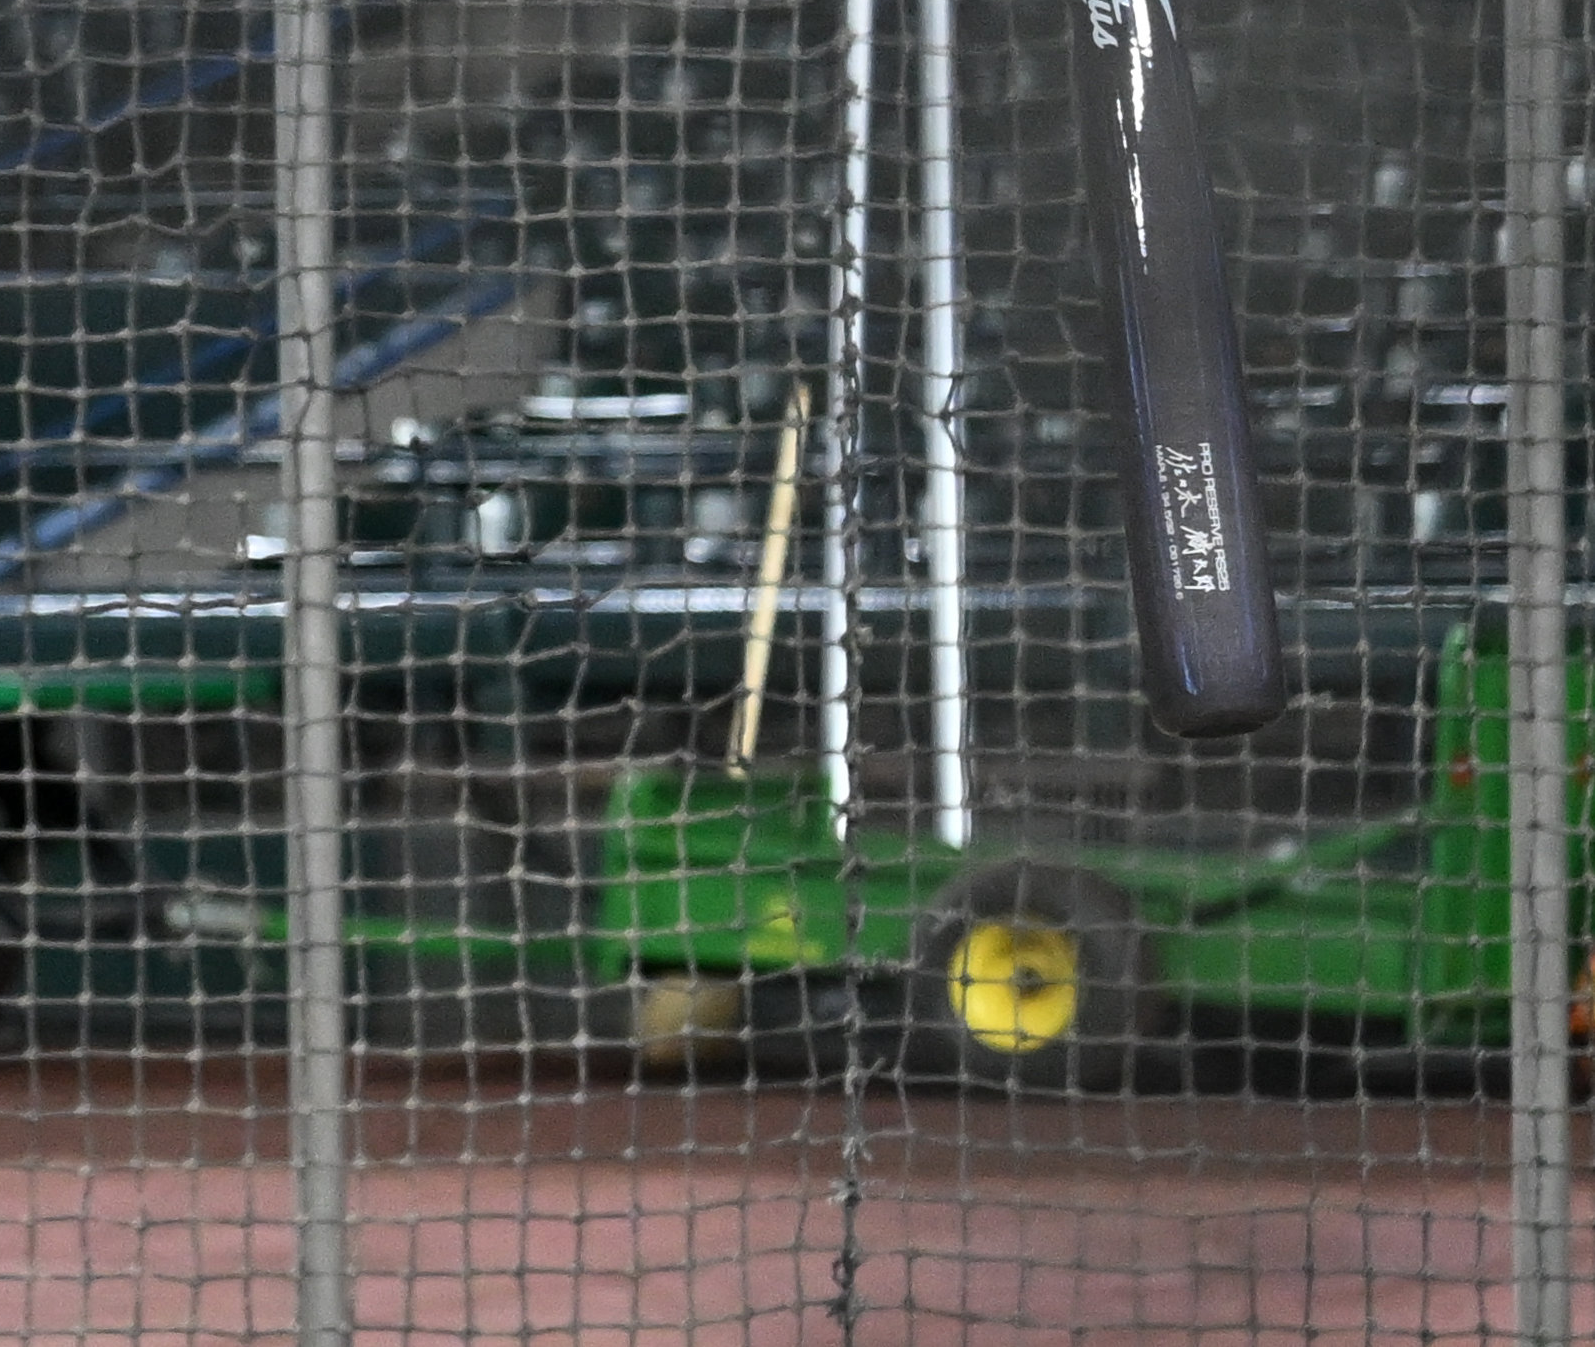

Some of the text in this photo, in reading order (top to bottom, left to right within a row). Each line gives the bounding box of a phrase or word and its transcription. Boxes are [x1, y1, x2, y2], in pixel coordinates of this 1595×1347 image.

[1198, 442, 1231, 591] PRO RESERVE RS25
